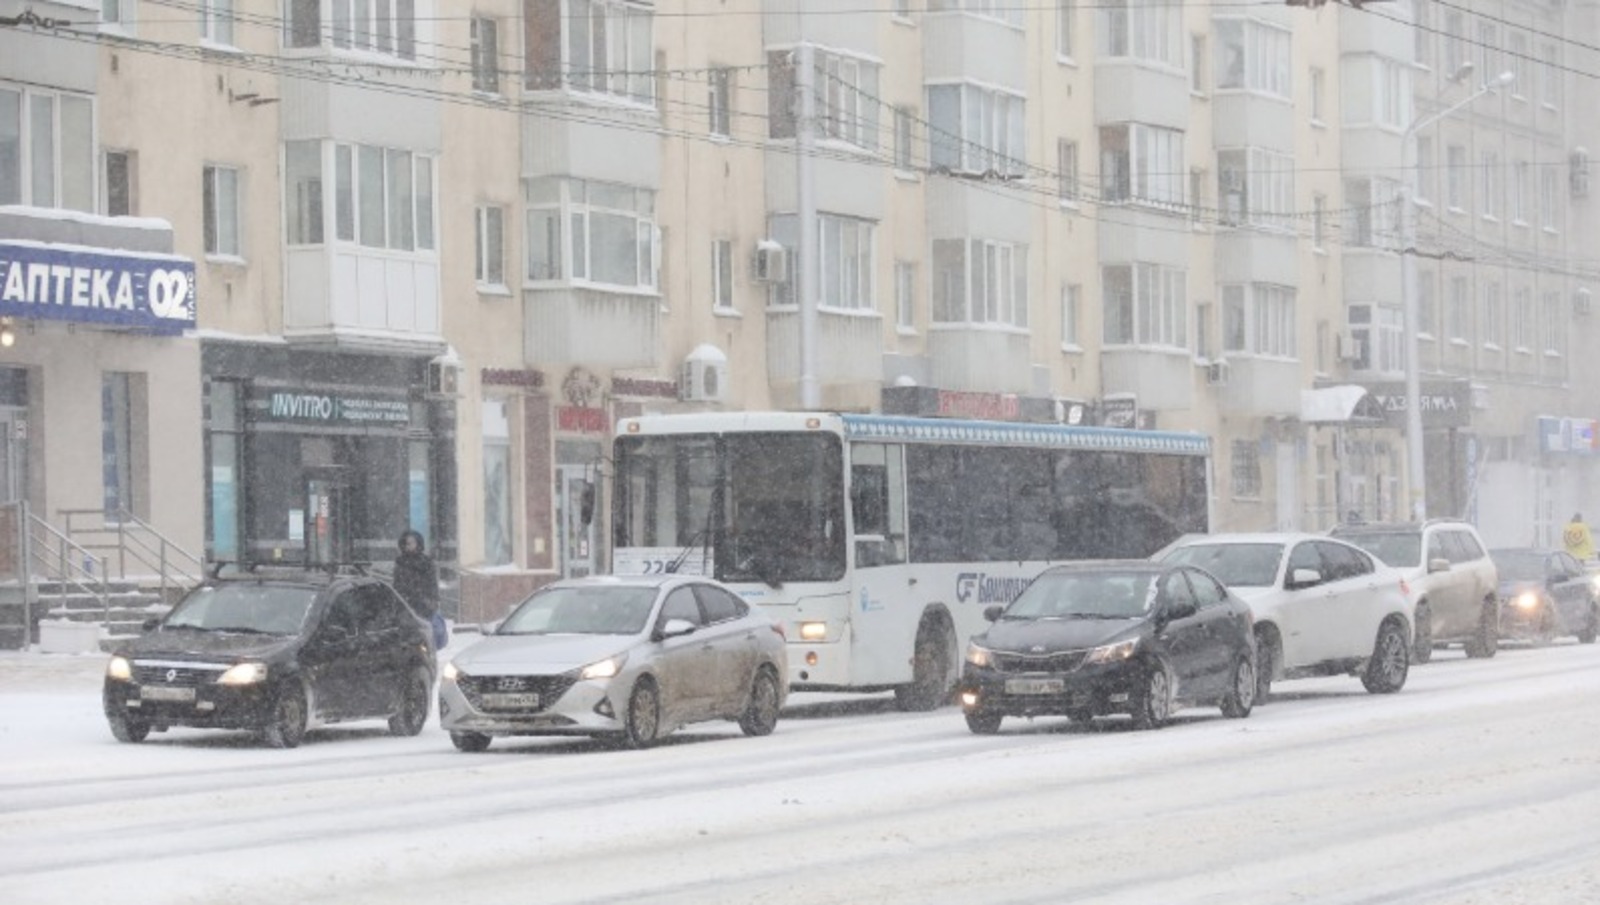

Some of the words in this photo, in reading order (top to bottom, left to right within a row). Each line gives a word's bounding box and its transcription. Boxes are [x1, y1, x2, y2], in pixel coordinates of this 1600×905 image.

[3, 261, 135, 311] АПТЕКА
[149, 268, 188, 320] 02
[272, 393, 332, 419] INVITRO
